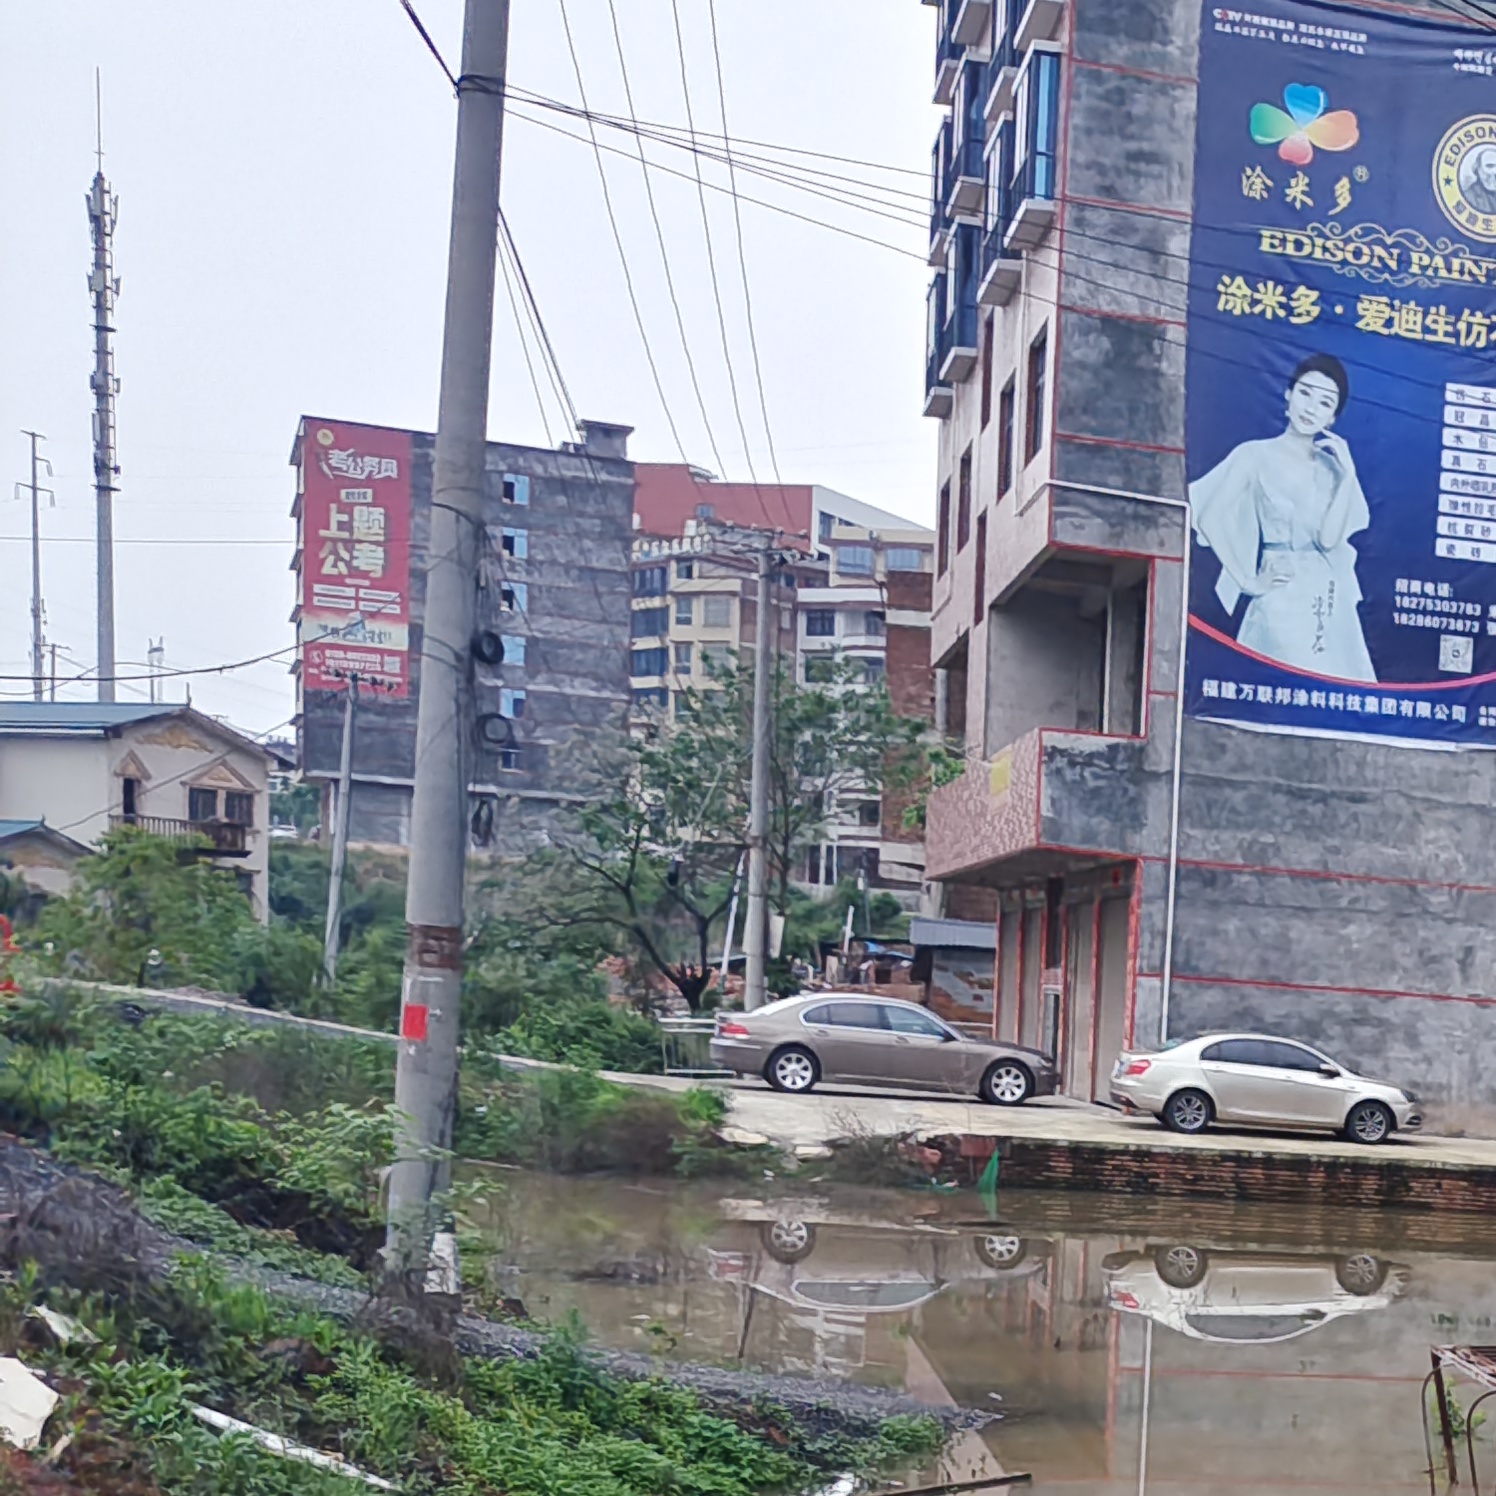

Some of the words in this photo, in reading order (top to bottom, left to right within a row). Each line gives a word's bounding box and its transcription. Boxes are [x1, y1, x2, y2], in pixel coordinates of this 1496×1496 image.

[1241, 164, 1352, 216] 涂米多
[1258, 230, 1401, 272] EDISON
